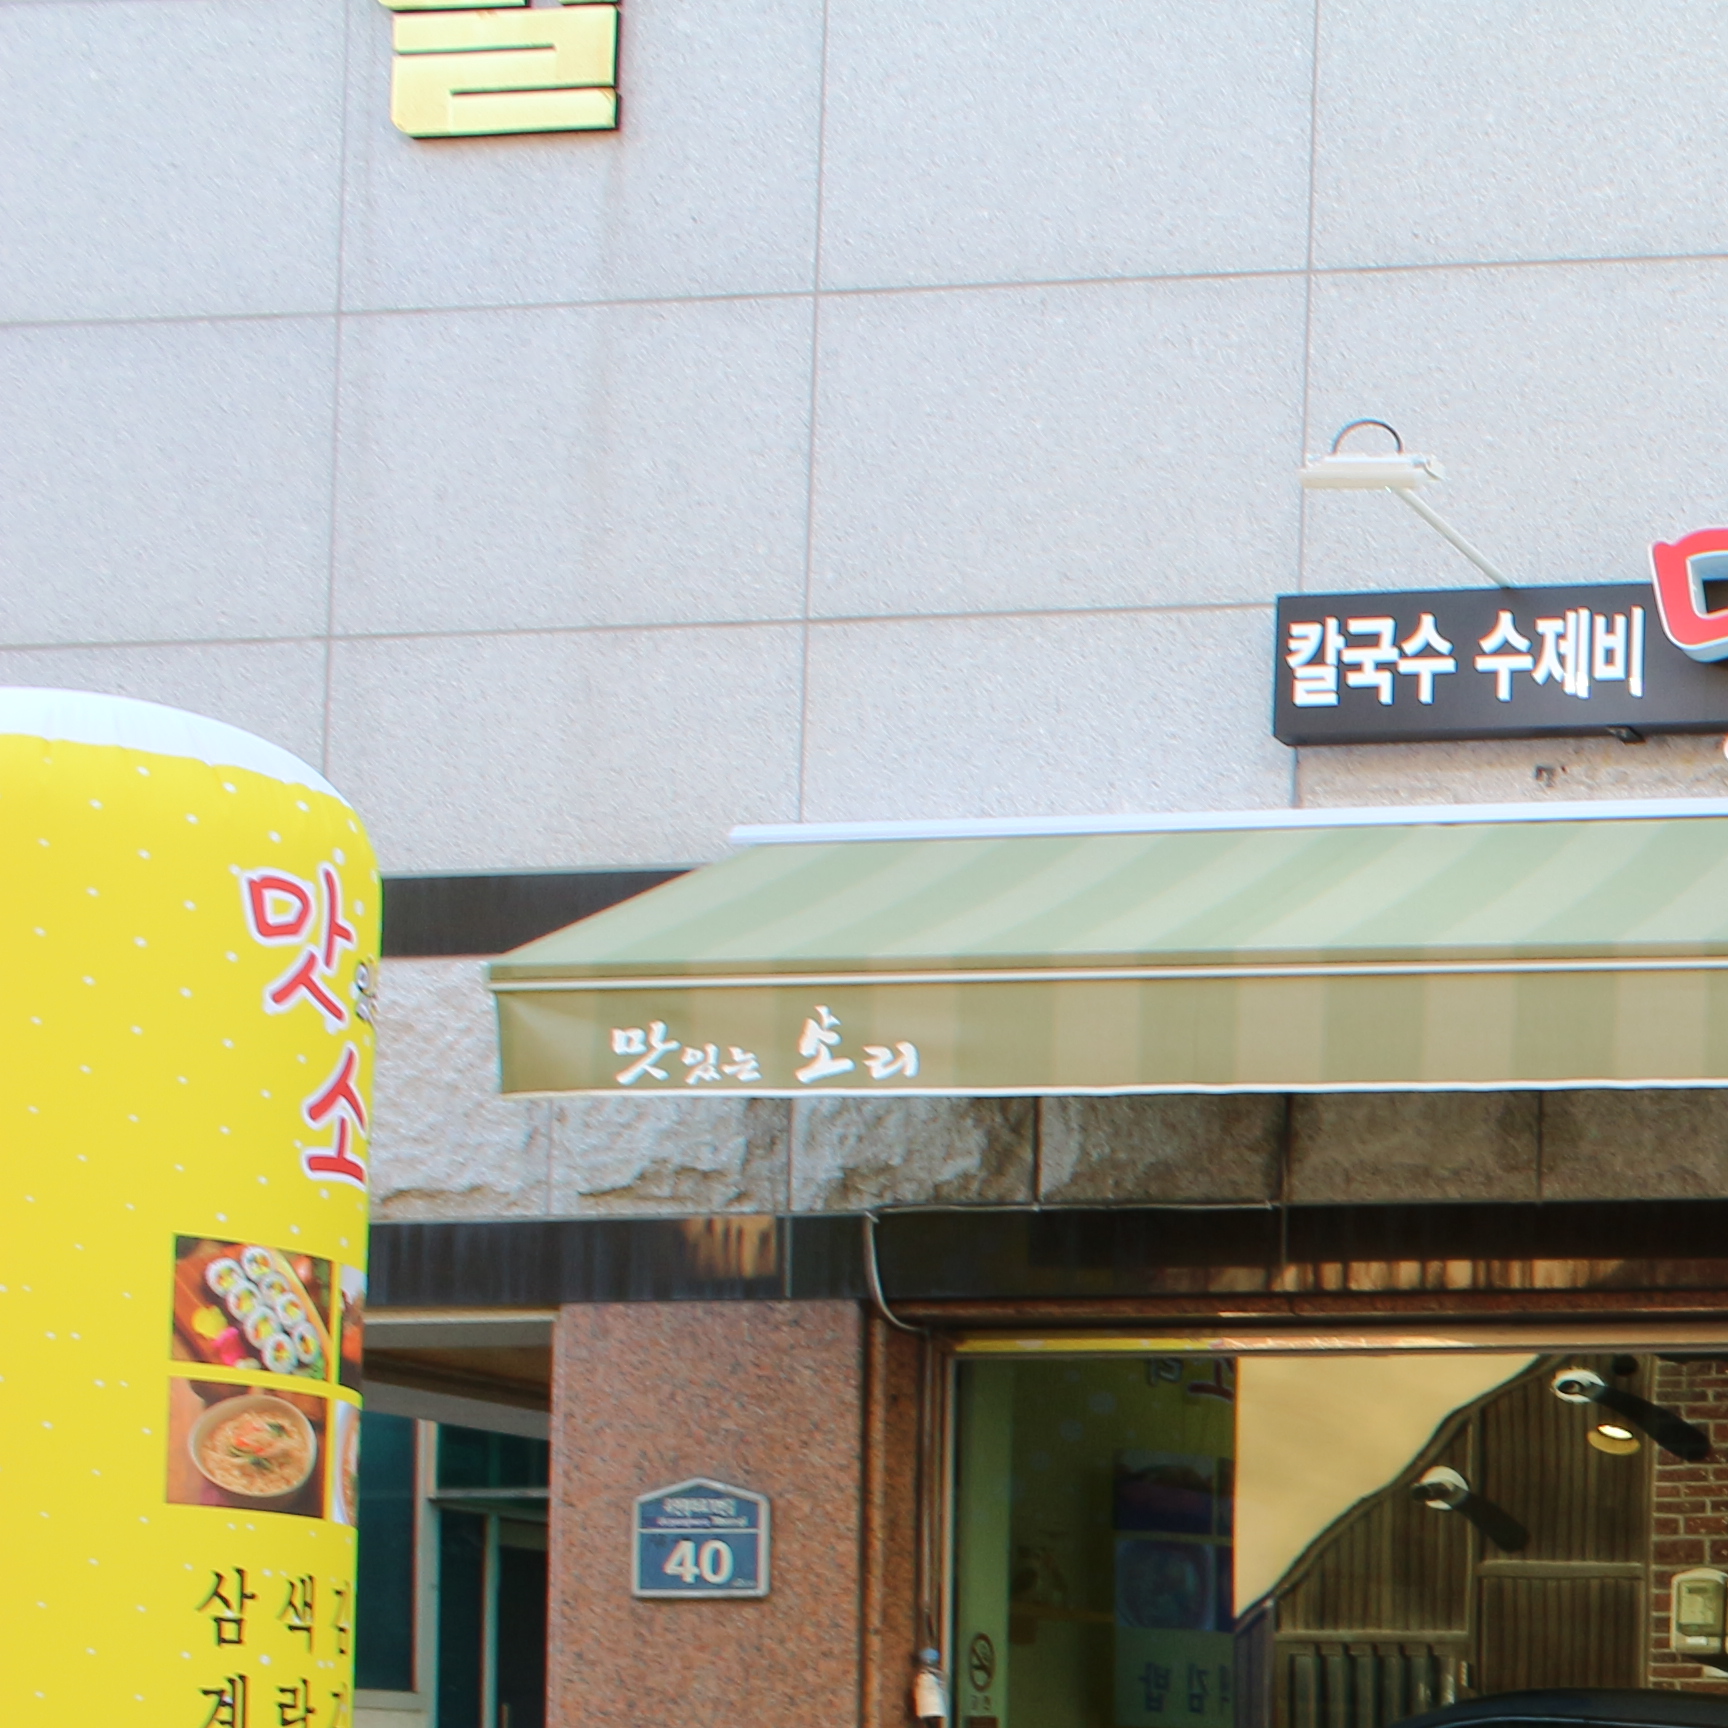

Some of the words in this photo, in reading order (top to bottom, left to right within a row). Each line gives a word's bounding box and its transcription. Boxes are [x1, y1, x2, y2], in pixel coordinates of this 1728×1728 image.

[1286, 613, 1458, 708] 칼국수
[1471, 606, 1647, 701] 수제비
[611, 1019, 762, 1086] 맛있는
[794, 1004, 920, 1084] 소리
[663, 1539, 735, 1585] 40
